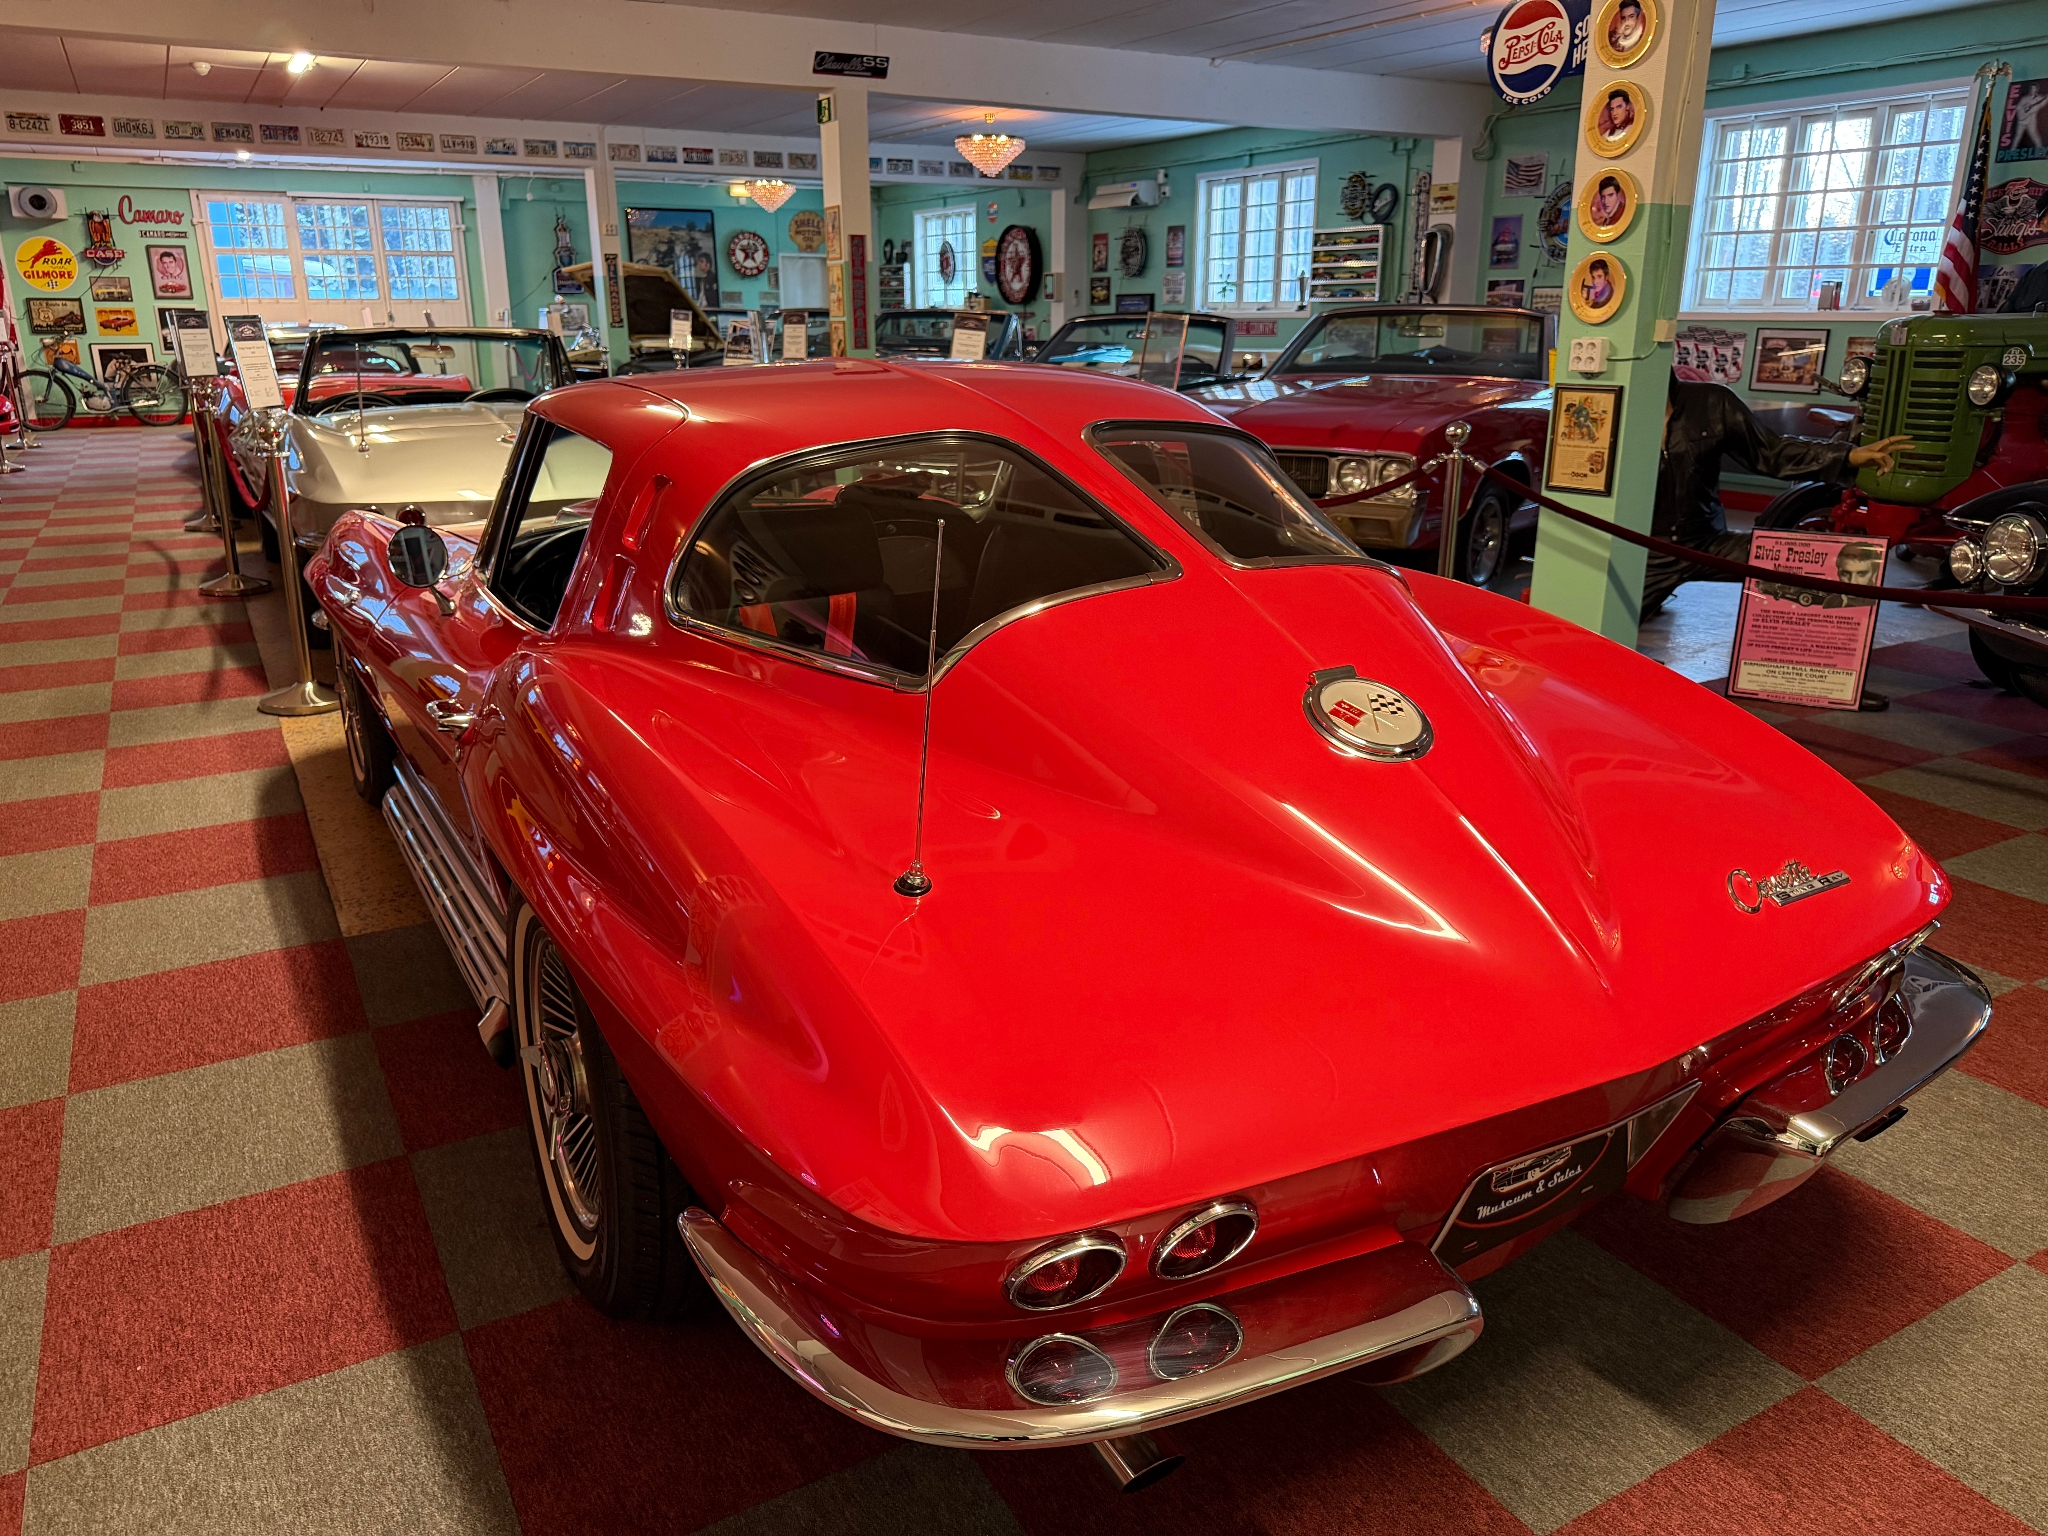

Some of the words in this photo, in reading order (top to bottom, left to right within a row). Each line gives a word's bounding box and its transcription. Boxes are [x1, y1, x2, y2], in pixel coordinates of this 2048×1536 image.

[863, 57, 888, 68] SS
[1502, 93, 1519, 105] ICE
[1522, 86, 1551, 105] COLD
[2000, 84, 2021, 147] ELVIS
[70, 119, 94, 130] 3851
[118, 194, 184, 225] Camaro
[1884, 228, 1937, 246] Coona
[86, 250, 123, 258] CASE
[1893, 244, 1927, 253] Etra
[42, 257, 72, 266] ROAR
[23, 270, 75, 280] GILMORE
[2004, 355, 2025, 365] 235
[1754, 545, 1781, 561] Elvis
[1786, 547, 1828, 567] Presley
[1777, 670, 1803, 678] CENTRE
[1827, 669, 1854, 677] CENTRE
[1476, 1189, 1533, 1220] Museum
[1536, 1180, 1545, 1192] &
[1547, 1164, 1583, 1188] Sales
